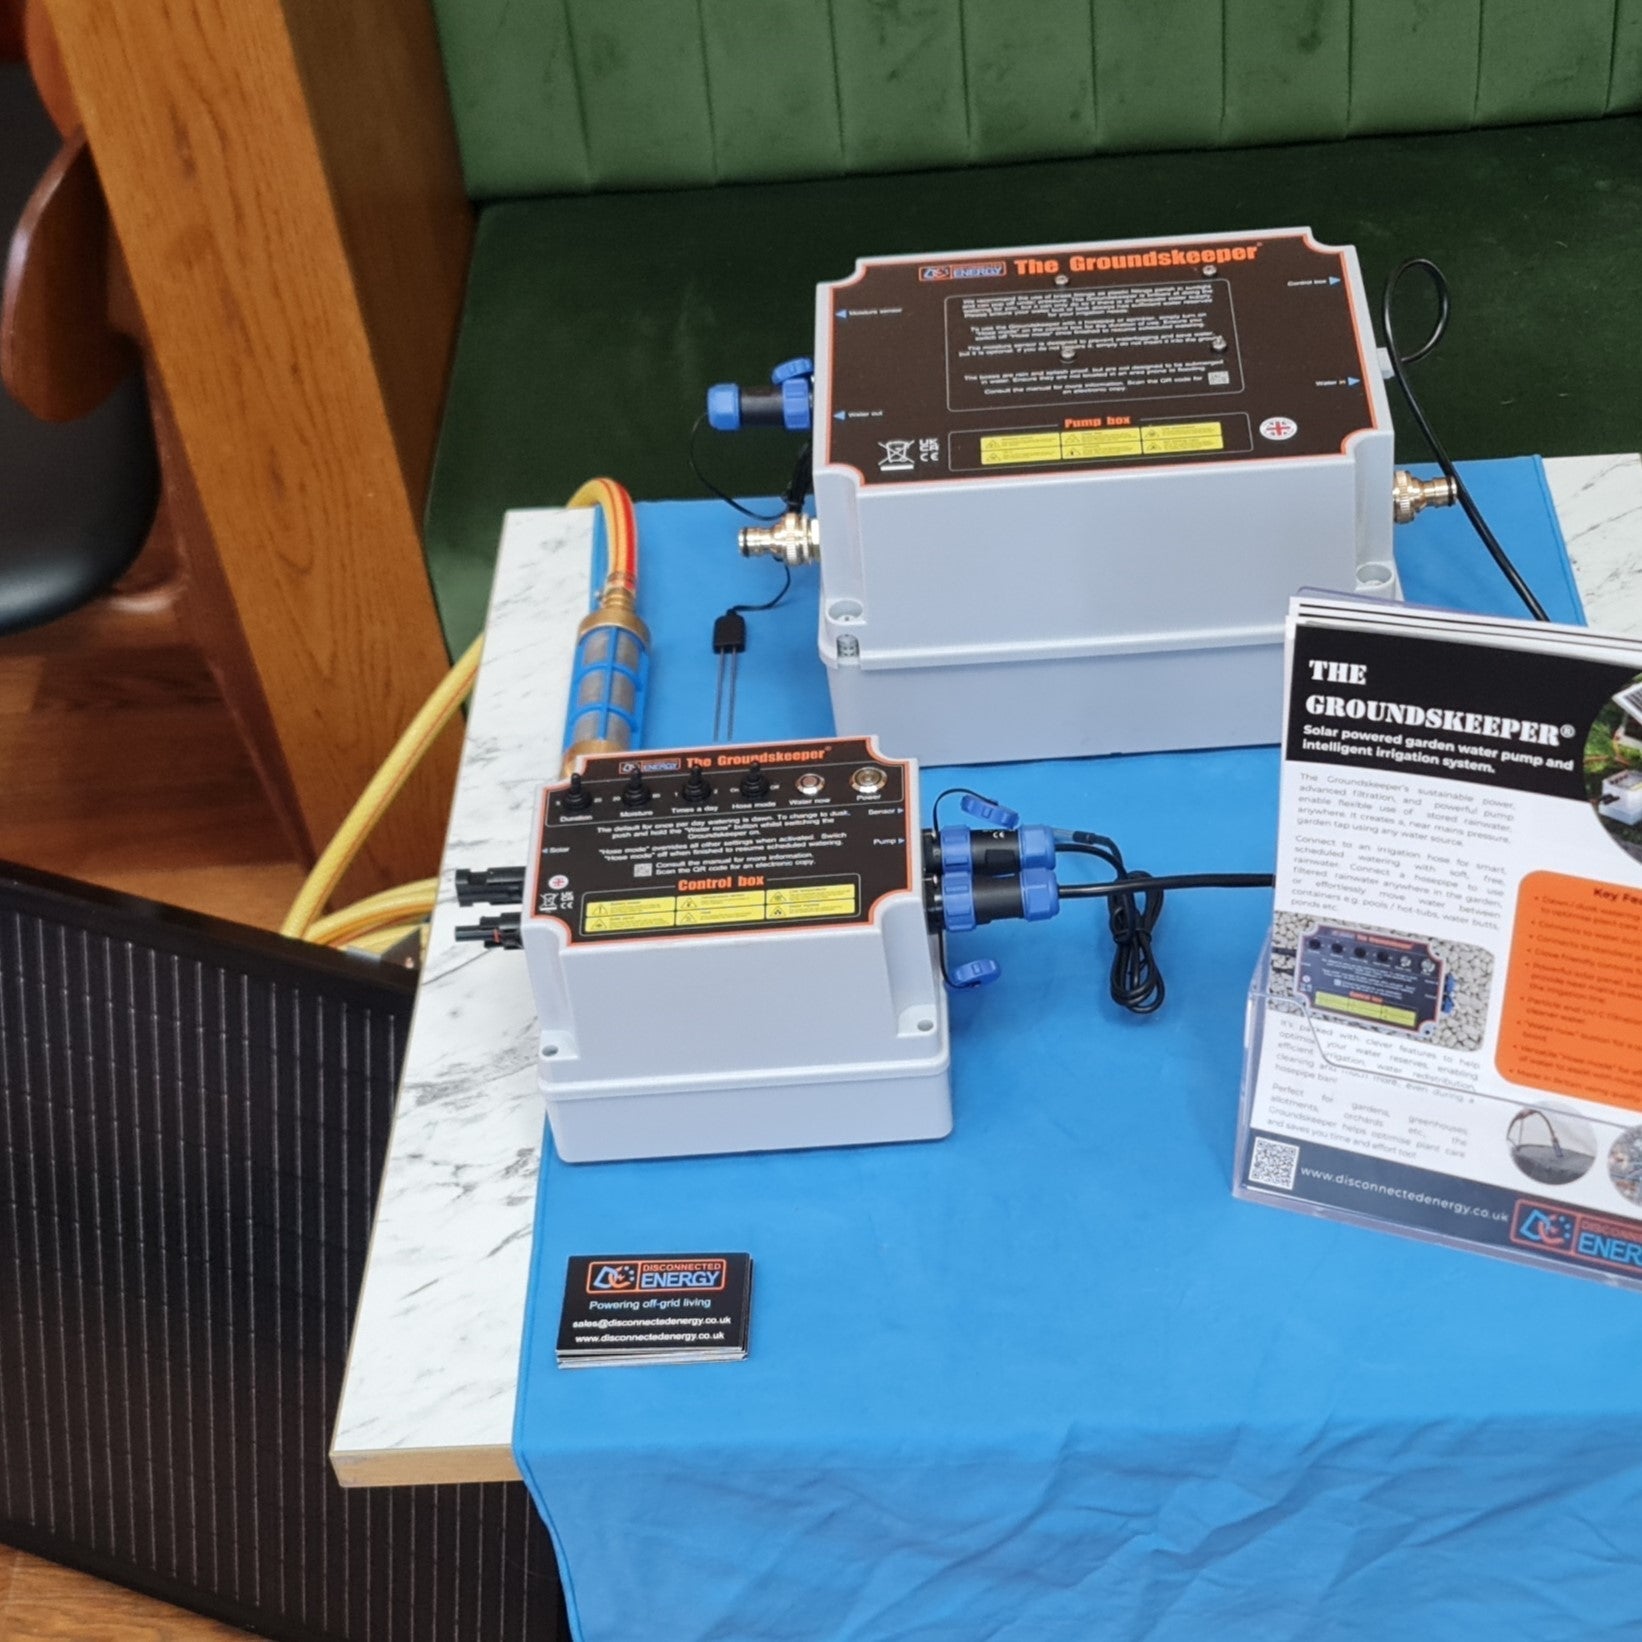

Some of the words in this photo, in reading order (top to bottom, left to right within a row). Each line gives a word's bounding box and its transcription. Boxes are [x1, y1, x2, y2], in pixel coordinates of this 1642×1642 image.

[1013, 258, 1060, 275] The
[1070, 246, 1258, 273] Groundskeeper
[1064, 417, 1101, 429] Pump
[1107, 416, 1131, 426] box
[1309, 660, 1367, 685] THE
[1302, 723, 1339, 737] Solar
[1340, 729, 1403, 745] powered
[1404, 736, 1455, 752] garden
[1457, 744, 1498, 758] water
[1500, 750, 1544, 767] pump
[1544, 757, 1574, 771] and
[1302, 737, 1373, 756] intelligent
[1375, 745, 1440, 765] irrigation
[1441, 756, 1495, 774] system.
[686, 756, 712, 768] The
[717, 750, 826, 766] Groundskeeper
[1300, 771, 1318, 782] The
[1417, 787, 1474, 802] sustainable
[1297, 795, 1332, 805] enable
[1337, 798, 1373, 810] flexible
[1378, 805, 1397, 813] use
[1402, 807, 1414, 815] of
[1426, 811, 1458, 823] stored
[1298, 784, 1347, 796] advanced
[1402, 797, 1422, 806] and
[1433, 802, 1478, 815] powerful
[1296, 817, 1332, 826] garden
[1333, 820, 1350, 830] tap
[1351, 823, 1379, 834] using
[1380, 827, 1399, 837] any
[1400, 830, 1428, 840] water
[1429, 835, 1463, 847] source.
[678, 876, 732, 891] Control
[738, 876, 764, 887] box
[1593, 888, 1618, 901] Key
[1300, 1165, 1508, 1223] www.disconnectedenergy.co.uk
[642, 1263, 721, 1272] DISCONNECTED
[641, 1271, 721, 1288] ENERGY
[589, 1300, 640, 1311] Powering
[642, 1299, 680, 1310] off-grid
[683, 1298, 711, 1308] living
[572, 1316, 731, 1329] sales@disconnectedenergy.co.uk
[575, 1331, 725, 1343] www.disconnectedenergy.co.uk
